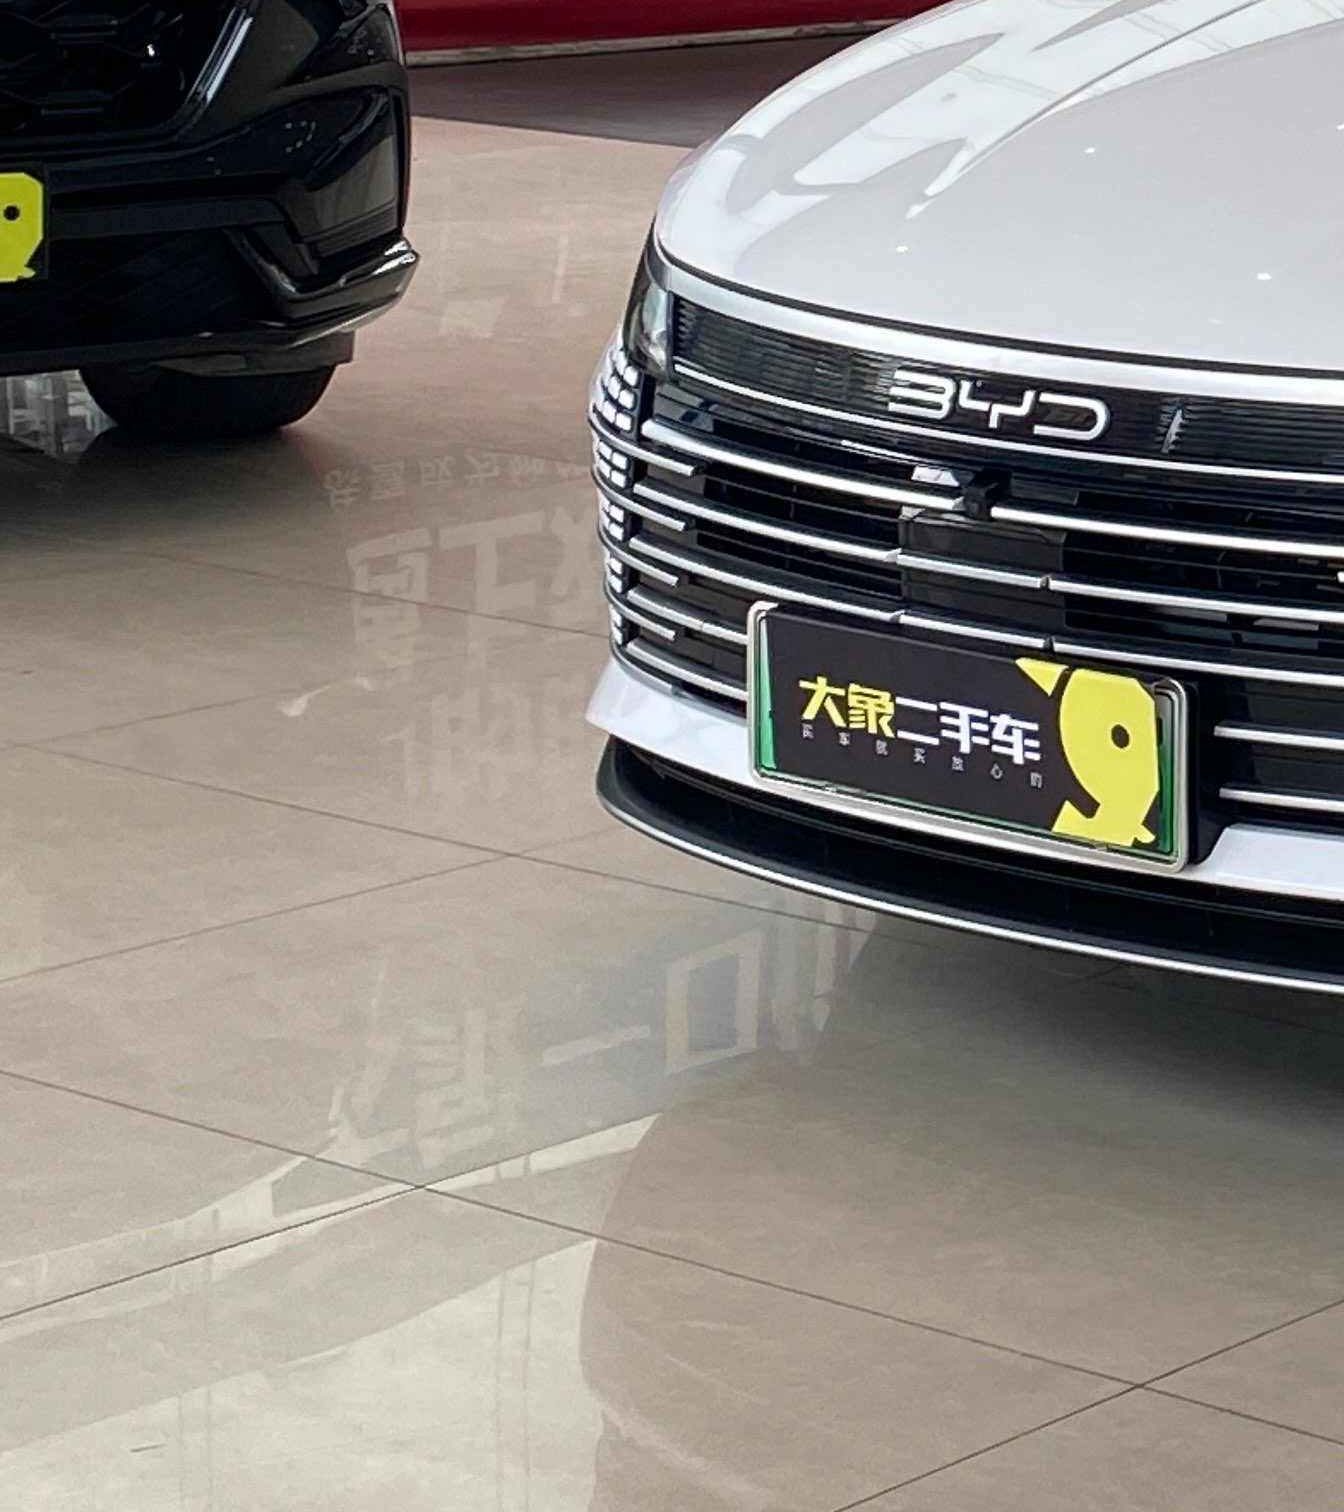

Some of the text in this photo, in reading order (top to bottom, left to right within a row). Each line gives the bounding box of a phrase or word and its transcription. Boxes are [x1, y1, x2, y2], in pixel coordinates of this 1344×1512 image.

[887, 368, 1112, 441] BYD
[799, 676, 1041, 766] 大象二手车
